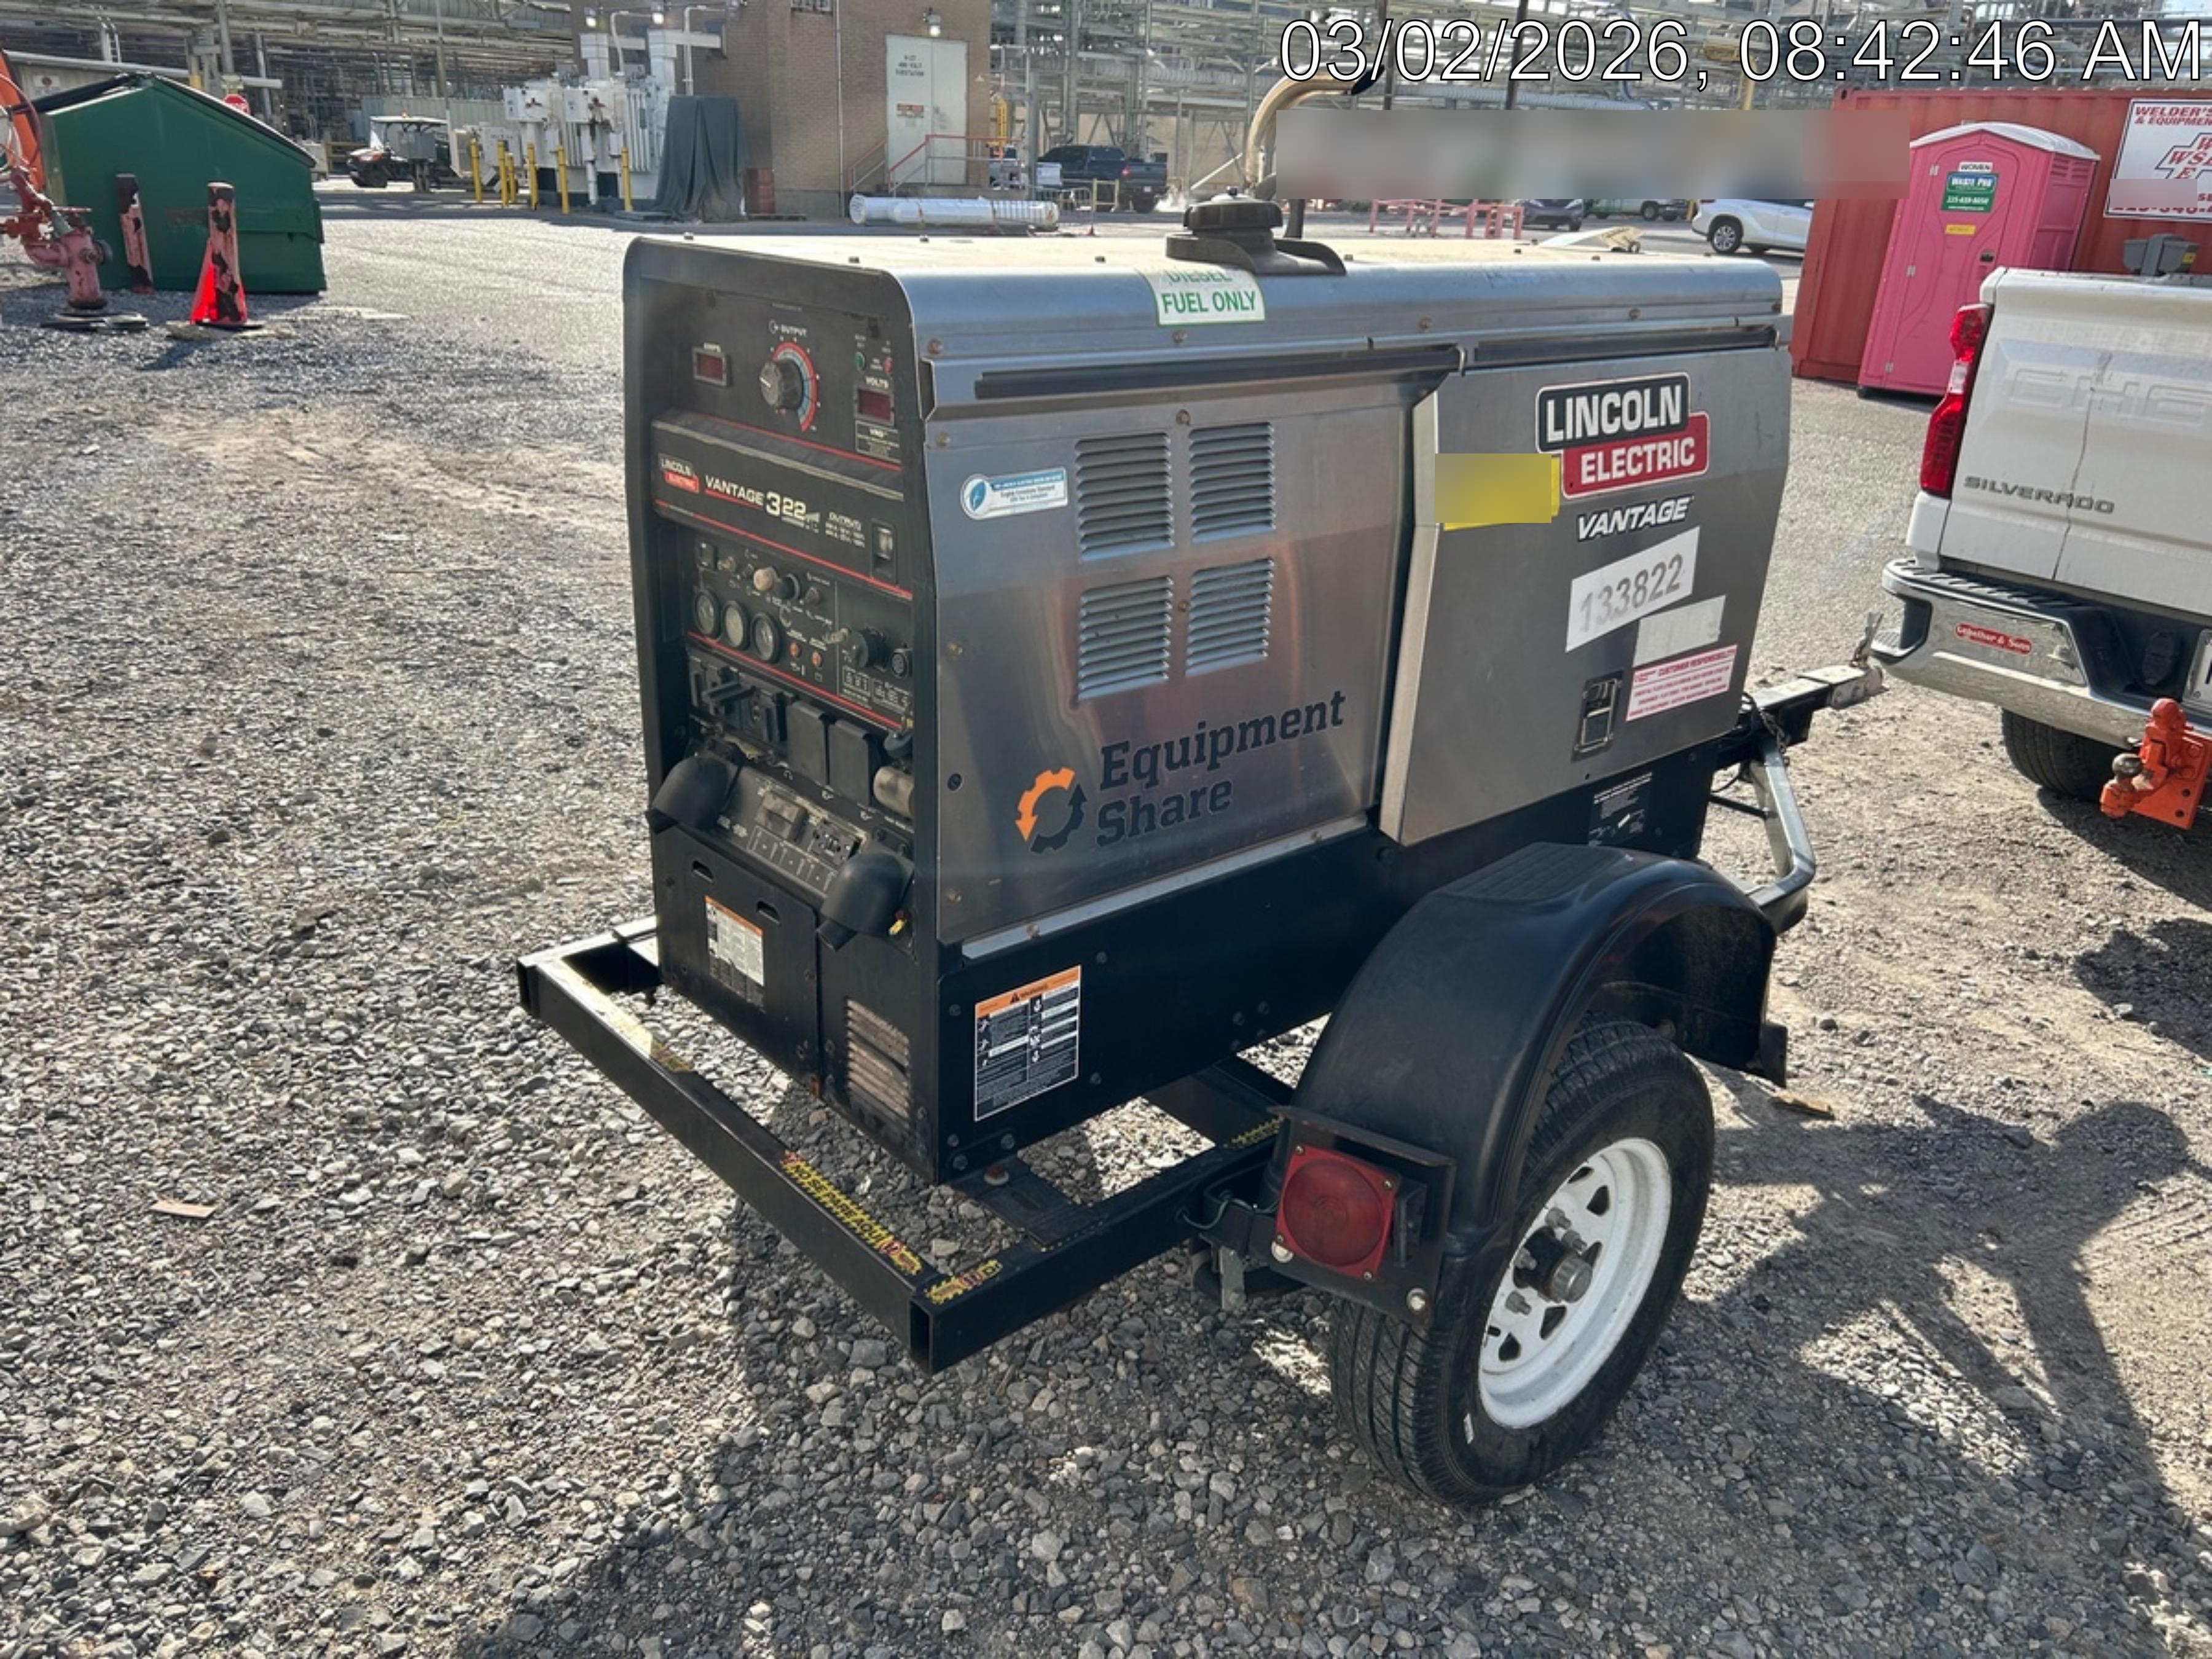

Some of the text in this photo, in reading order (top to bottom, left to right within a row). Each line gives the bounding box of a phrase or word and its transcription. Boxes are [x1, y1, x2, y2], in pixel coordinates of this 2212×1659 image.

[1161, 290, 1256, 314] FUEL ONLY
[1545, 384, 1682, 444] LINCOLN
[1580, 436, 1696, 485] ELECTRIC
[705, 475, 764, 506] VANTAGE
[766, 491, 807, 520] 322
[1577, 495, 1692, 541] VANTAGE
[1964, 475, 2116, 515] SILVERADO
[1580, 553, 1684, 633] 133822
[1099, 690, 1346, 791] Equipment
[1096, 779, 1233, 847] Share
